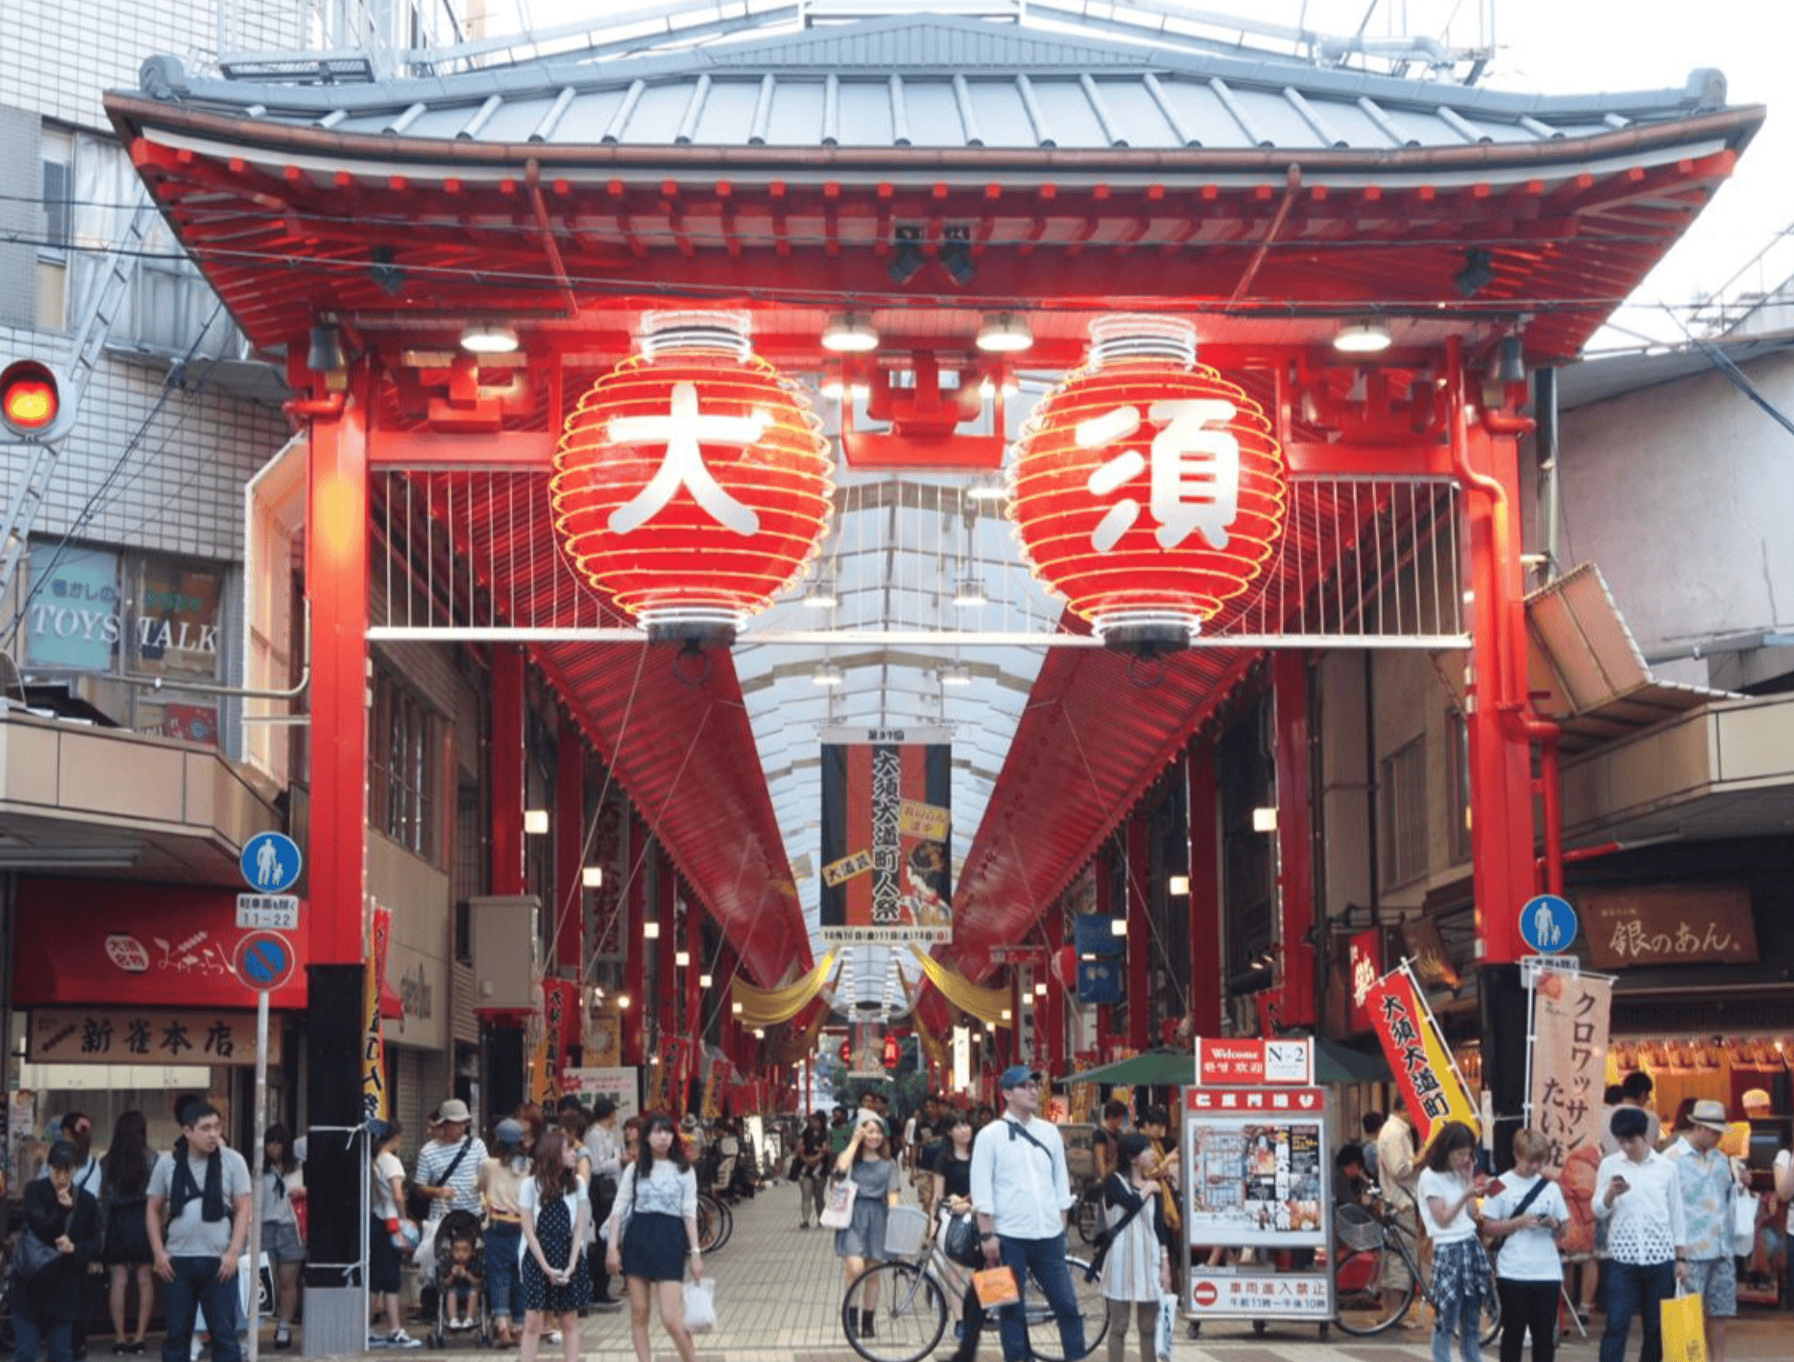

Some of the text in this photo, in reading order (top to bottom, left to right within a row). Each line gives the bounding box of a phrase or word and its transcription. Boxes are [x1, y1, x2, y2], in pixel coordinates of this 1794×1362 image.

[607, 382, 764, 536] 大
[1075, 400, 1239, 552] 須
[32, 602, 221, 654] TOYS TALK
[874, 751, 899, 921] 大須大道町人祭
[81, 1017, 234, 1058] 新雀本店
[1211, 1048, 1259, 1060] Welcome
[1384, 996, 1450, 1119] 大須大道町
[1567, 990, 1597, 1151] クロワッサン
[1230, 1282, 1326, 1296] 車両進入禁止
